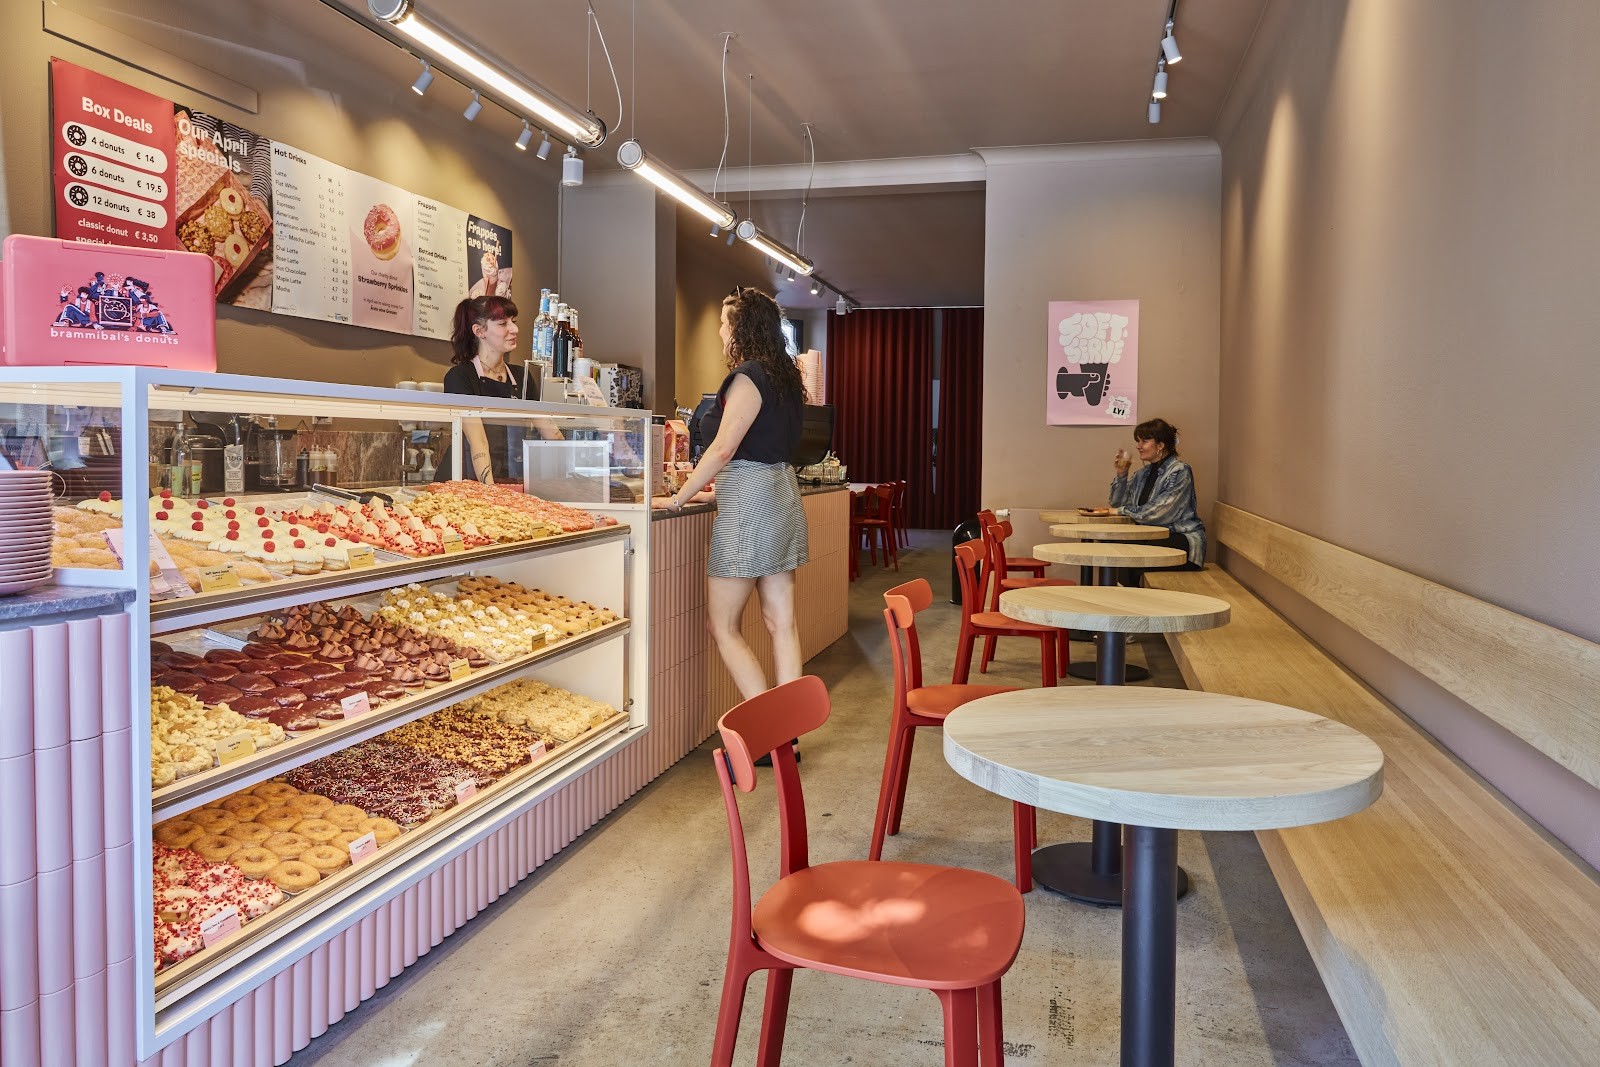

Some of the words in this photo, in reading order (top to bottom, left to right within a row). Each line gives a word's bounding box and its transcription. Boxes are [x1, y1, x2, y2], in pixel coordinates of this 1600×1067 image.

[82, 97, 110, 119] Box
[114, 108, 153, 134] Deals
[178, 119, 208, 140] Our
[212, 131, 248, 156] April
[100, 140, 125, 154] donuts
[146, 155, 154, 163] 14
[180, 141, 240, 172] specials
[274, 148, 288, 158] Hot
[288, 152, 306, 165] Drinks
[100, 169, 124, 182] donuts
[146, 183, 162, 192] 19,5
[92, 196, 102, 205] 12
[104, 199, 130, 212] donuts
[146, 210, 156, 218] 38
[78, 218, 104, 231] classic
[106, 225, 128, 237] donut
[135, 230, 140, 239] €
[142, 232, 158, 243] 3,50
[468, 220, 498, 241] Frappés
[468, 237, 481, 250] are
[482, 240, 502, 256] here!
[285, 267, 306, 276] Chocolate
[358, 275, 387, 289] Strawberry
[388, 282, 408, 293] Sprinkles
[50, 328, 130, 342] brammibal's
[136, 334, 178, 345] donuts
[1059, 312, 1128, 346] SOFT
[1064, 337, 1124, 364] SERVE
[1113, 407, 1125, 416] LY!
